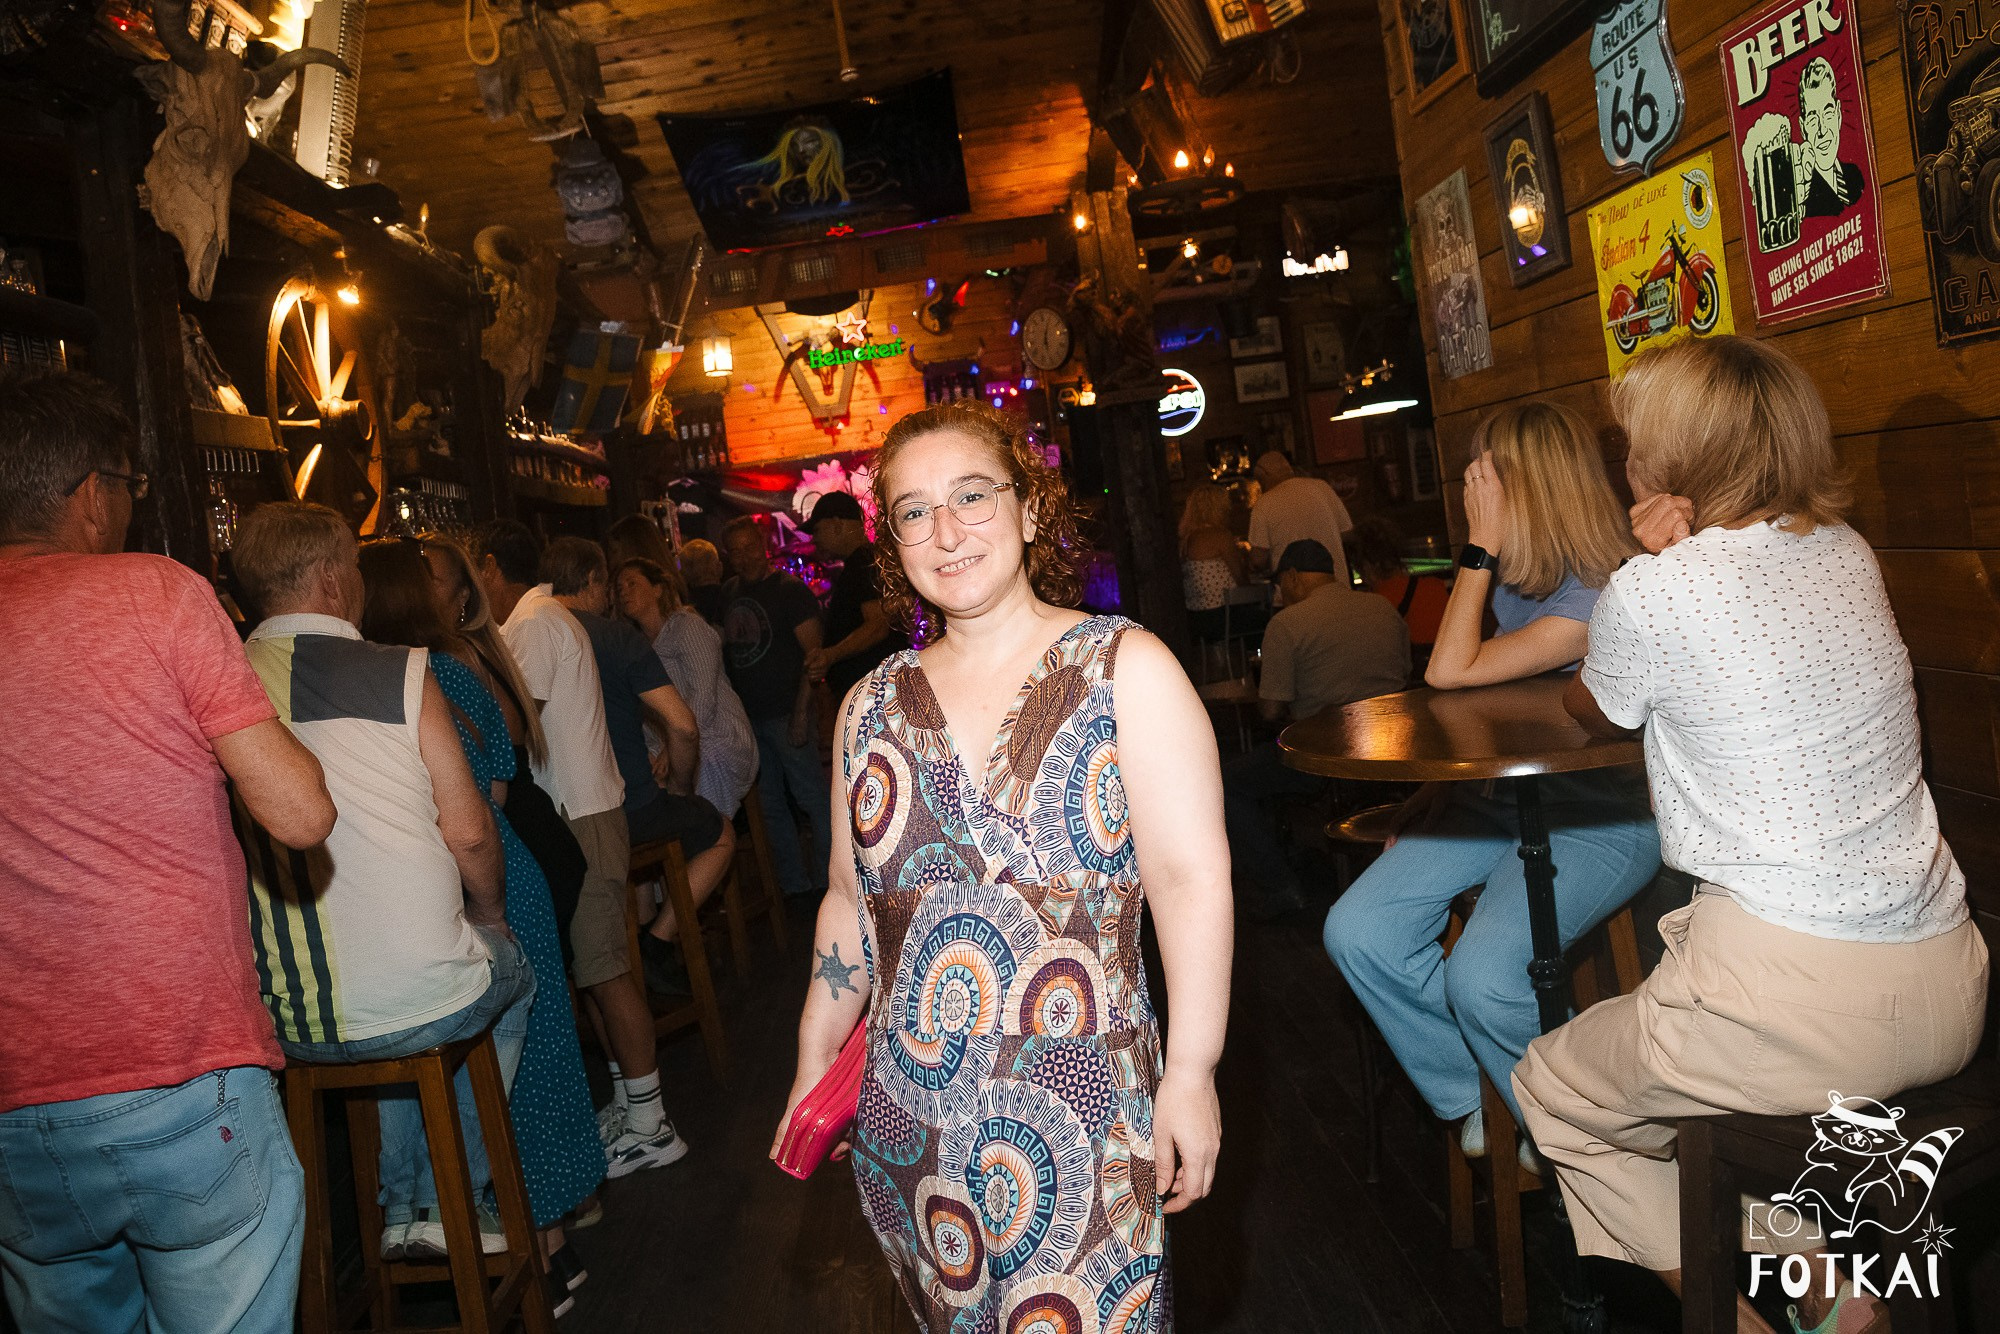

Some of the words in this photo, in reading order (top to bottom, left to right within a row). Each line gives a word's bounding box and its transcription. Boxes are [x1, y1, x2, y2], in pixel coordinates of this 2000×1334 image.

[1601, 2, 1647, 56] ROUTE
[1730, 0, 1842, 106] BEER
[1611, 67, 1659, 158] 66
[1647, 184, 1667, 204] LUXE
[1601, 236, 1636, 271] Indian
[1639, 219, 1650, 254] 4
[1768, 253, 1802, 287] HELPING
[1803, 238, 1823, 264] UGLY
[1826, 214, 1862, 250] PEOPLE
[1771, 281, 1792, 307] HAVE
[1810, 255, 1834, 283] SINCE
[1836, 235, 1864, 266] 1862!
[1965, 310, 1990, 325] AND
[808, 338, 903, 369] Heineken
